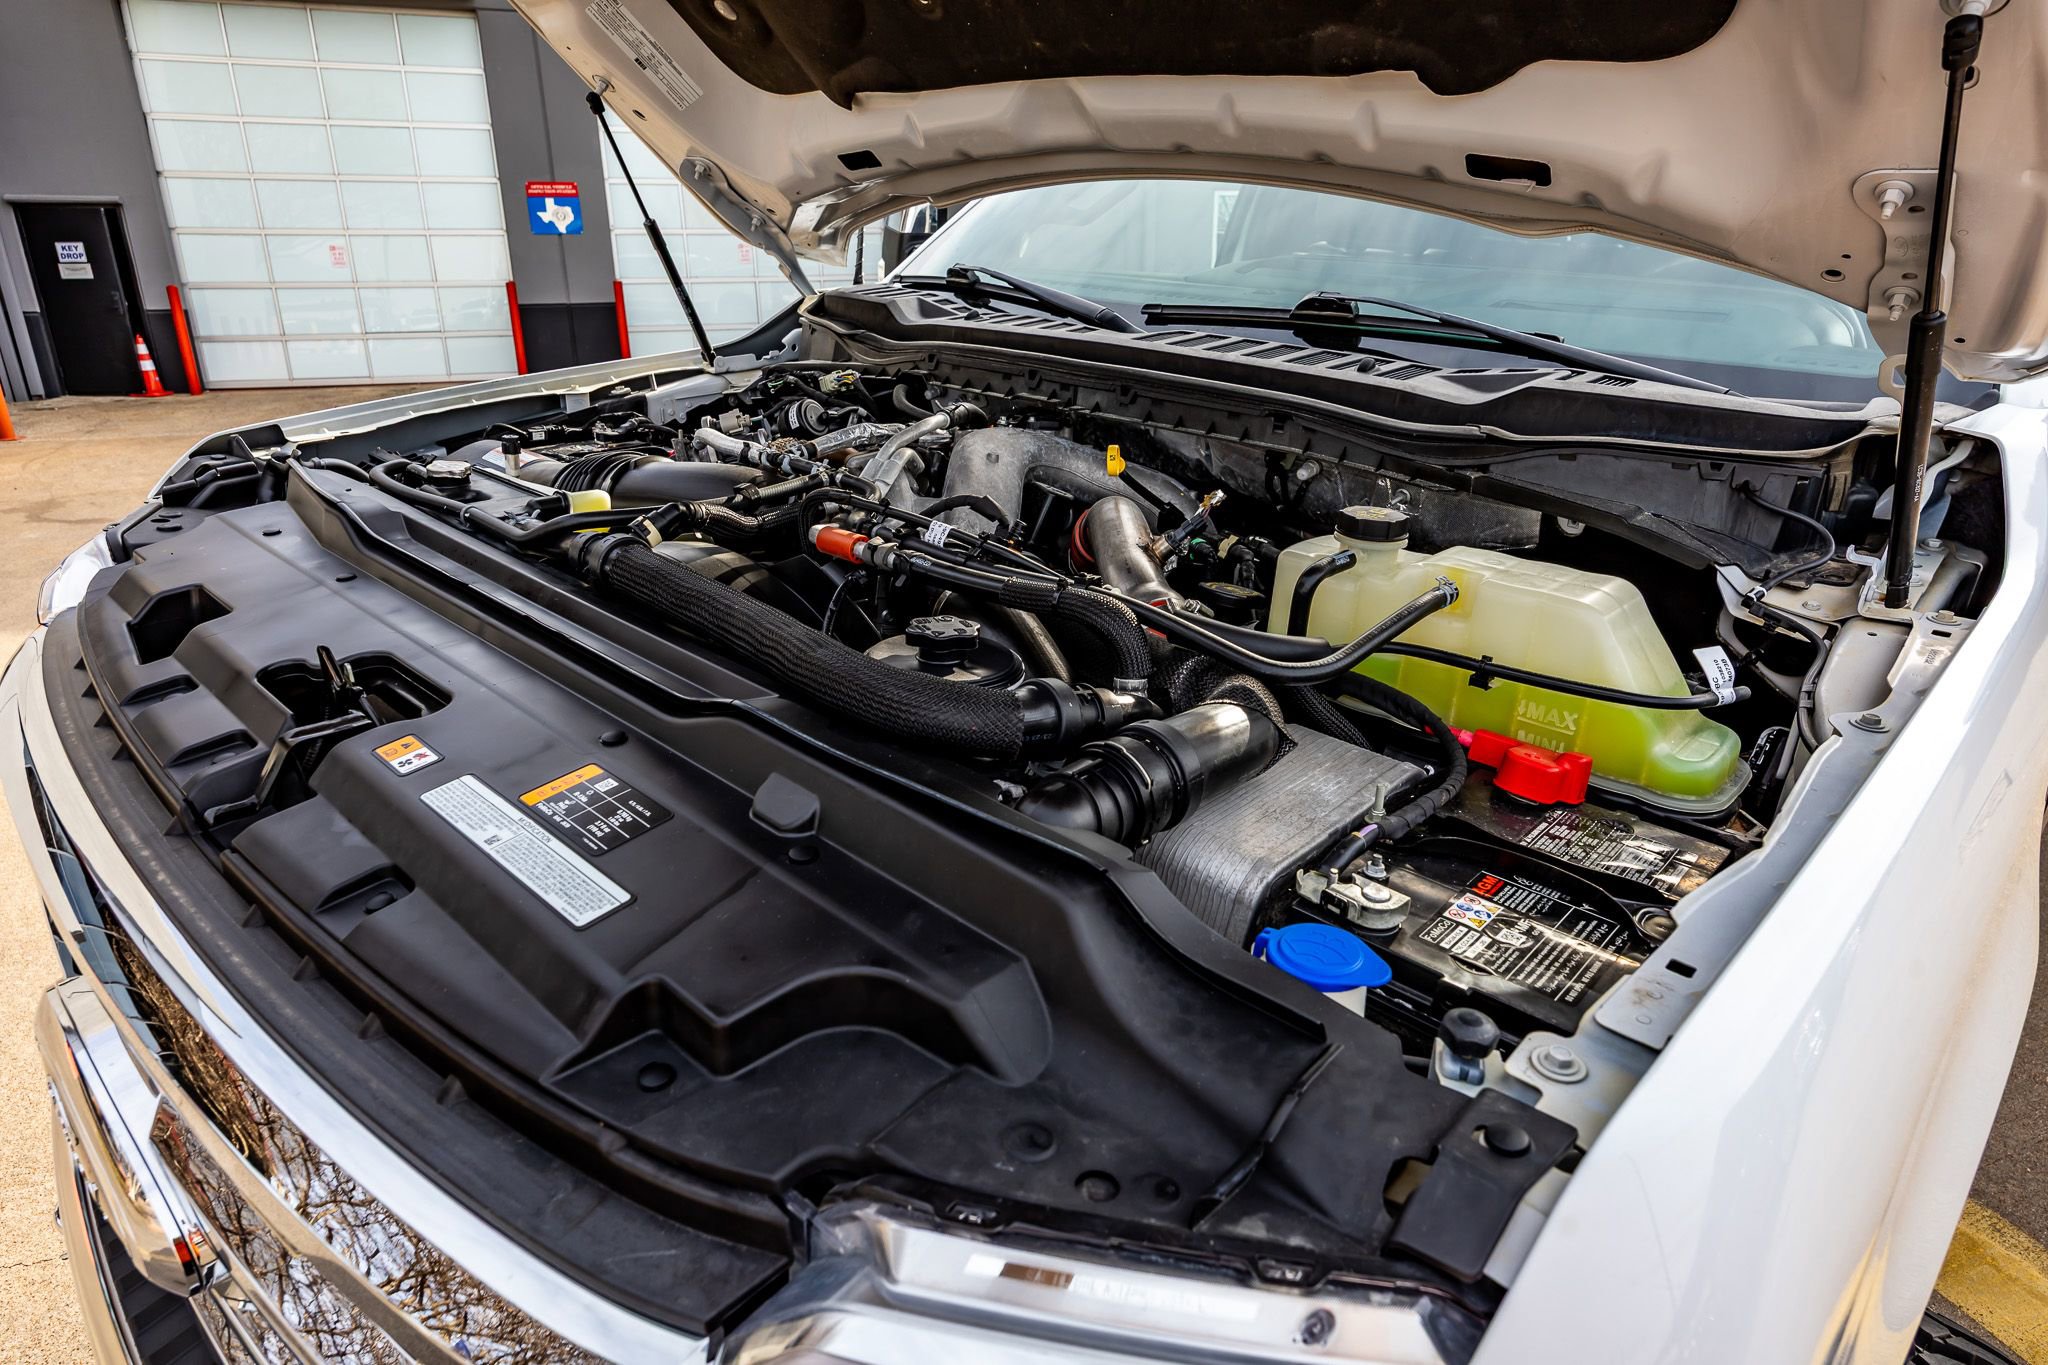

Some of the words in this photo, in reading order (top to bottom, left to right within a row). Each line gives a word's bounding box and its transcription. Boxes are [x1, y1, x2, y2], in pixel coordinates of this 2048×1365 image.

[1526, 701, 1579, 731] MAX
[1472, 875, 1499, 897] AGM
[1424, 920, 1451, 942] FoMoCo
